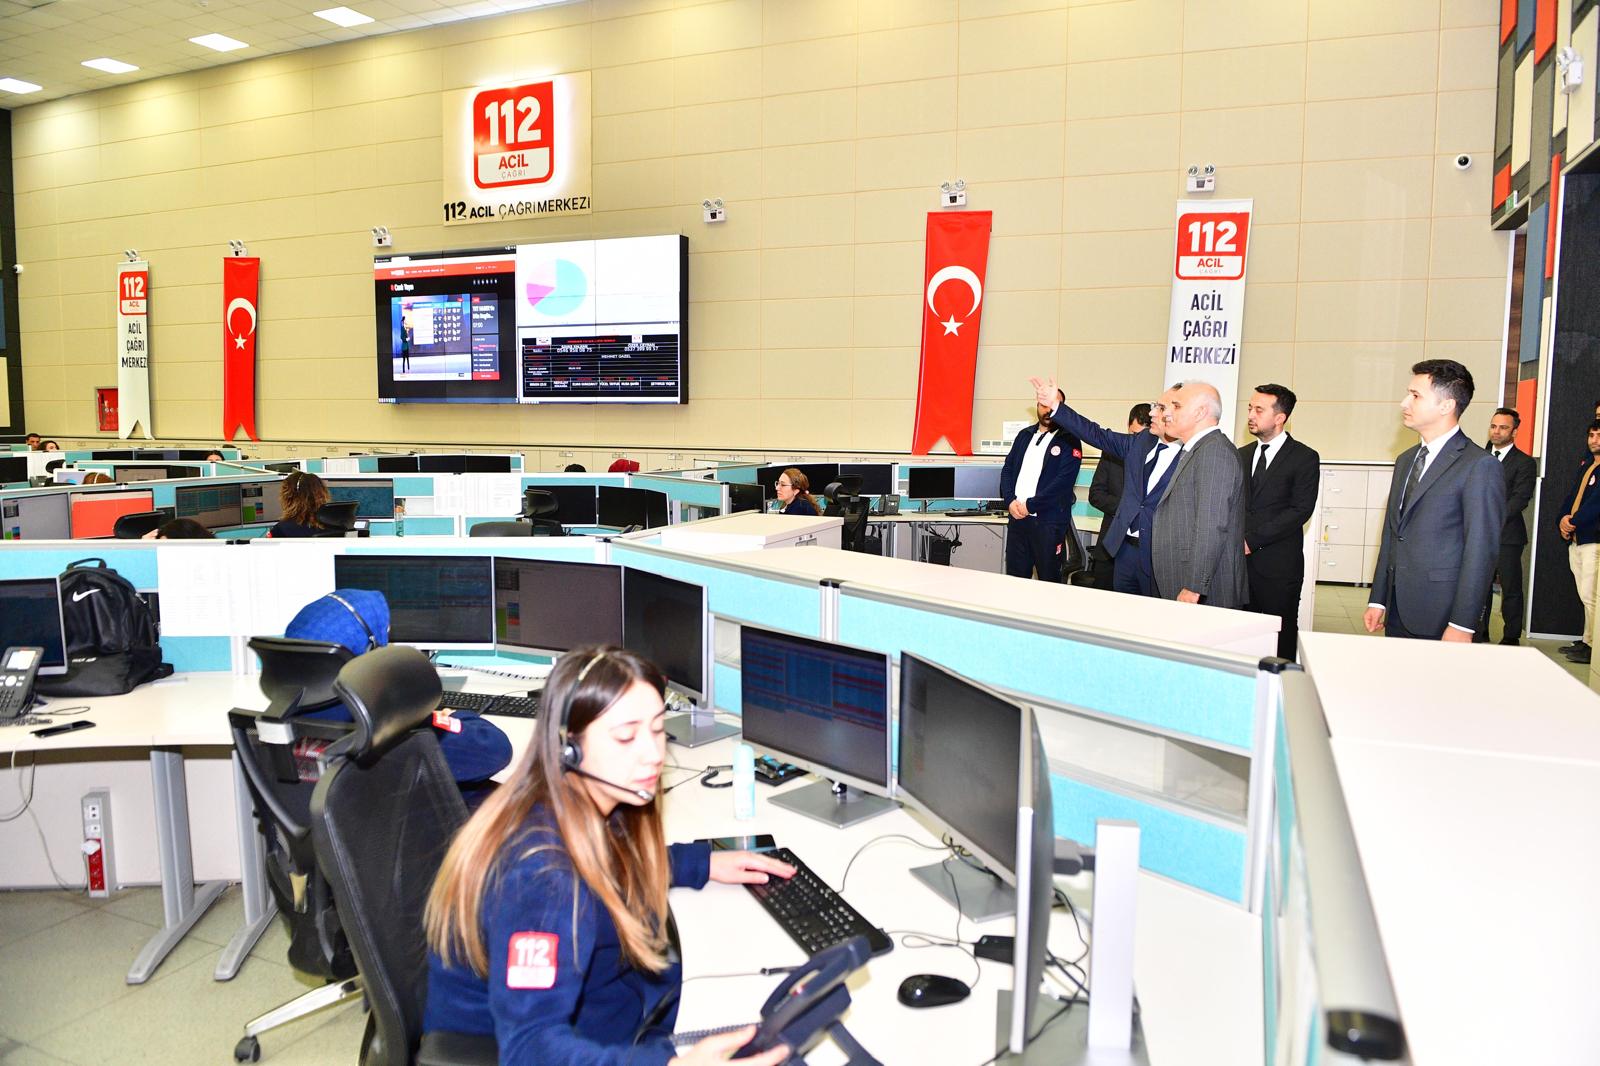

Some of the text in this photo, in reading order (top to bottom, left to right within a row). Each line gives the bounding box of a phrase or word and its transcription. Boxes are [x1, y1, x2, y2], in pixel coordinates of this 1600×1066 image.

[484, 96, 542, 146] 112
[443, 201, 467, 221] 112
[1188, 220, 1238, 252] 112
[123, 276, 145, 298] 112
[1190, 289, 1224, 311] ACİL
[128, 320, 142, 335] ACİL
[1182, 315, 1228, 341] ÇAĞRI
[126, 336, 145, 354] ÇAĞRI
[1171, 343, 1236, 365] MERKEZİ
[515, 937, 550, 966] 112
